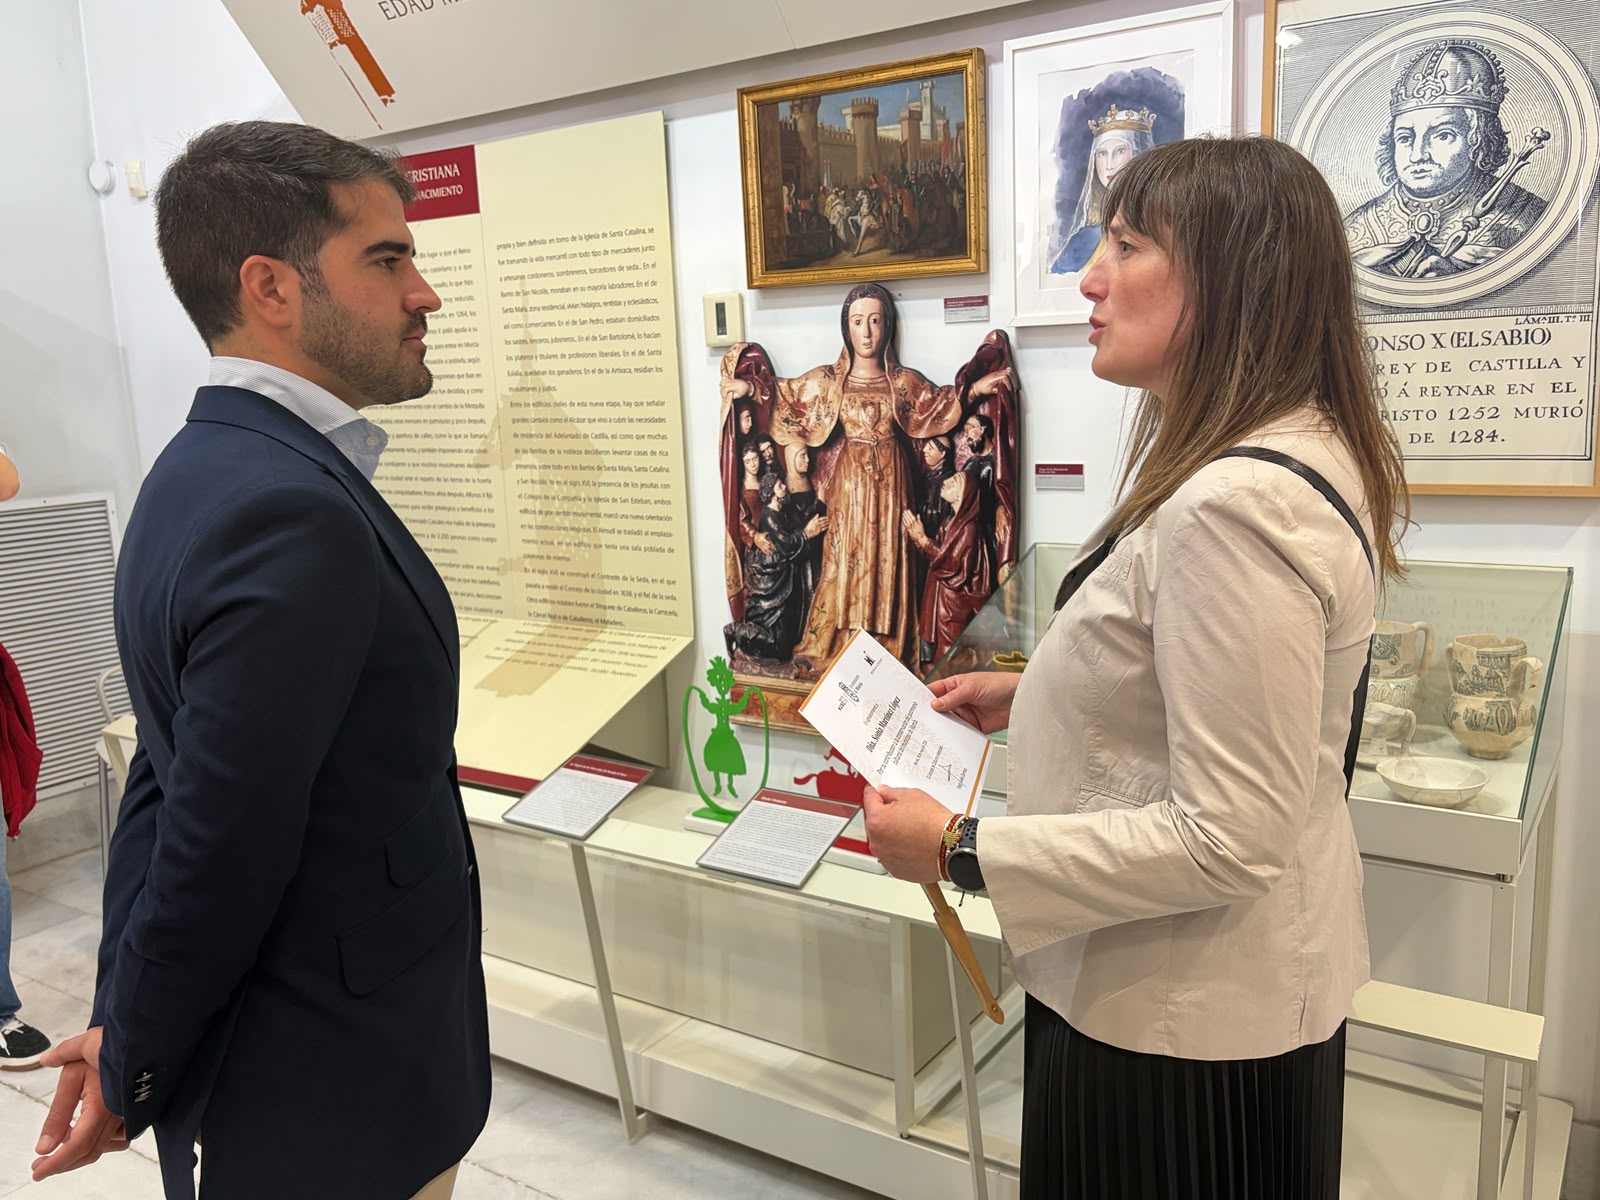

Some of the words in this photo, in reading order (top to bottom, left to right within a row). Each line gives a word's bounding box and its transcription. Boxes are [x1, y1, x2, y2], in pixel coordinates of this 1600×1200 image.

[378, 0, 434, 20] EDAD
[1366, 333, 1426, 351] ONSO
[1430, 332, 1448, 349] X
[1377, 362, 1417, 376] REY
[1425, 361, 1452, 374] DE
[1468, 357, 1563, 372] CASTILLA
[1572, 355, 1587, 369] Y
[1396, 381, 1410, 398] Á
[1419, 384, 1496, 398] REYNAR
[1506, 382, 1535, 395] EN
[1550, 381, 1577, 394] EL
[1380, 408, 1438, 422] RISTO
[1448, 406, 1501, 421] 1252
[1513, 399, 1584, 419] MURIÓ
[1408, 432, 1435, 444] DE
[1448, 429, 1505, 444] 1284.
[872, 728, 883, 742] Sonia
[879, 709, 893, 728] Martínez
[889, 696, 900, 710] López
